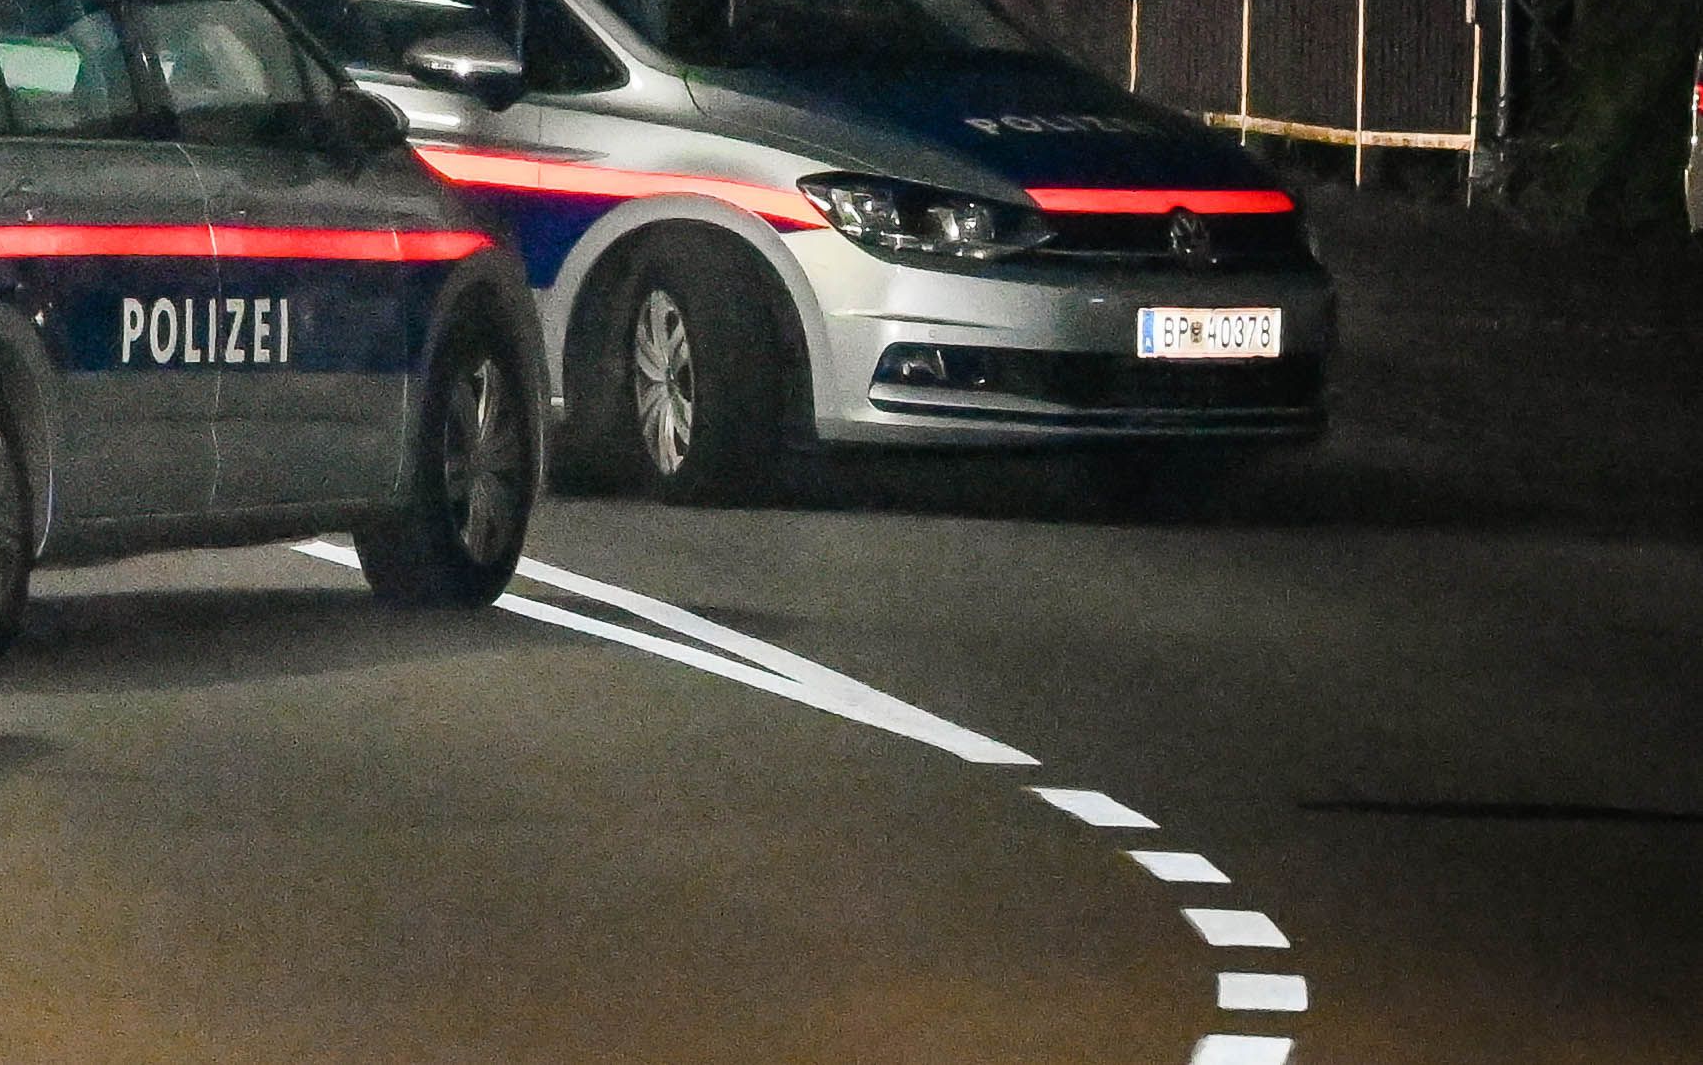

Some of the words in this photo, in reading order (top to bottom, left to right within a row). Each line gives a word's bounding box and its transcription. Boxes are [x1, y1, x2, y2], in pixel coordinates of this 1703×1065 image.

[964, 115, 1167, 135] POLIZ
[122, 297, 289, 364] POLIZEI
[1208, 316, 1271, 348] 40378
